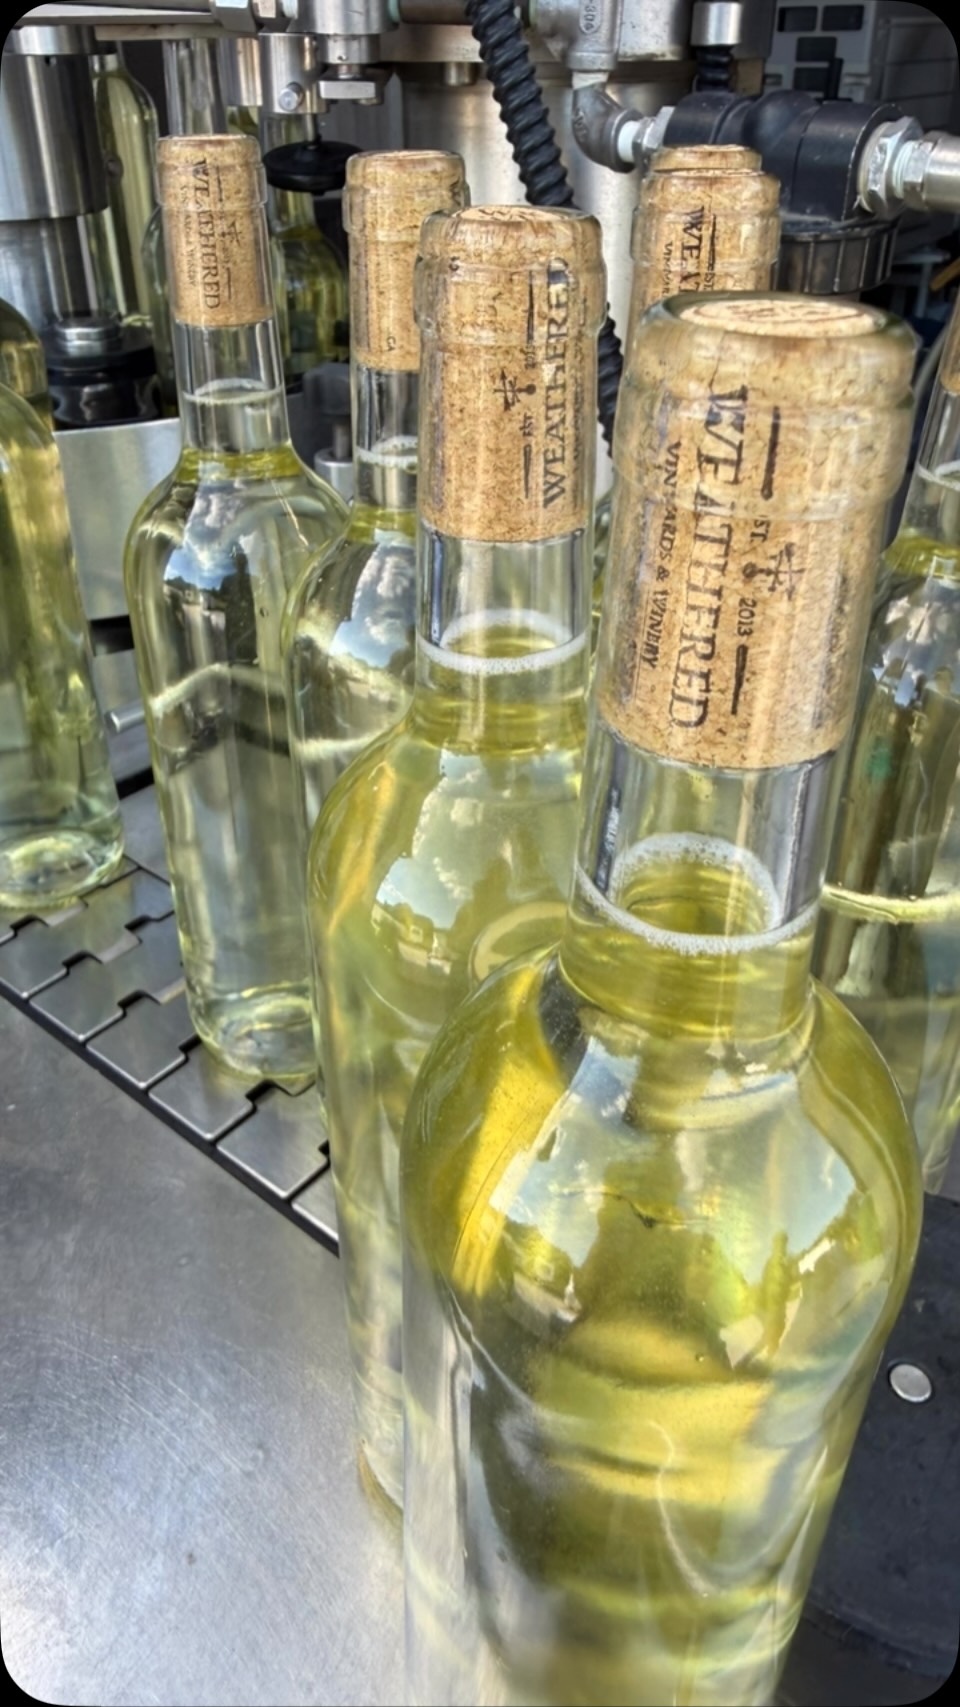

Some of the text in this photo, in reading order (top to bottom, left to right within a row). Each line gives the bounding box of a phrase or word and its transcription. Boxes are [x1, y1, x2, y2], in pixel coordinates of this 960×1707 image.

[543, 257, 569, 509] WEATHERED
[641, 440, 682, 669] VINARDS & WINERY
[670, 384, 748, 729] WEATHERED
[738, 514, 771, 636] ST. 2013
